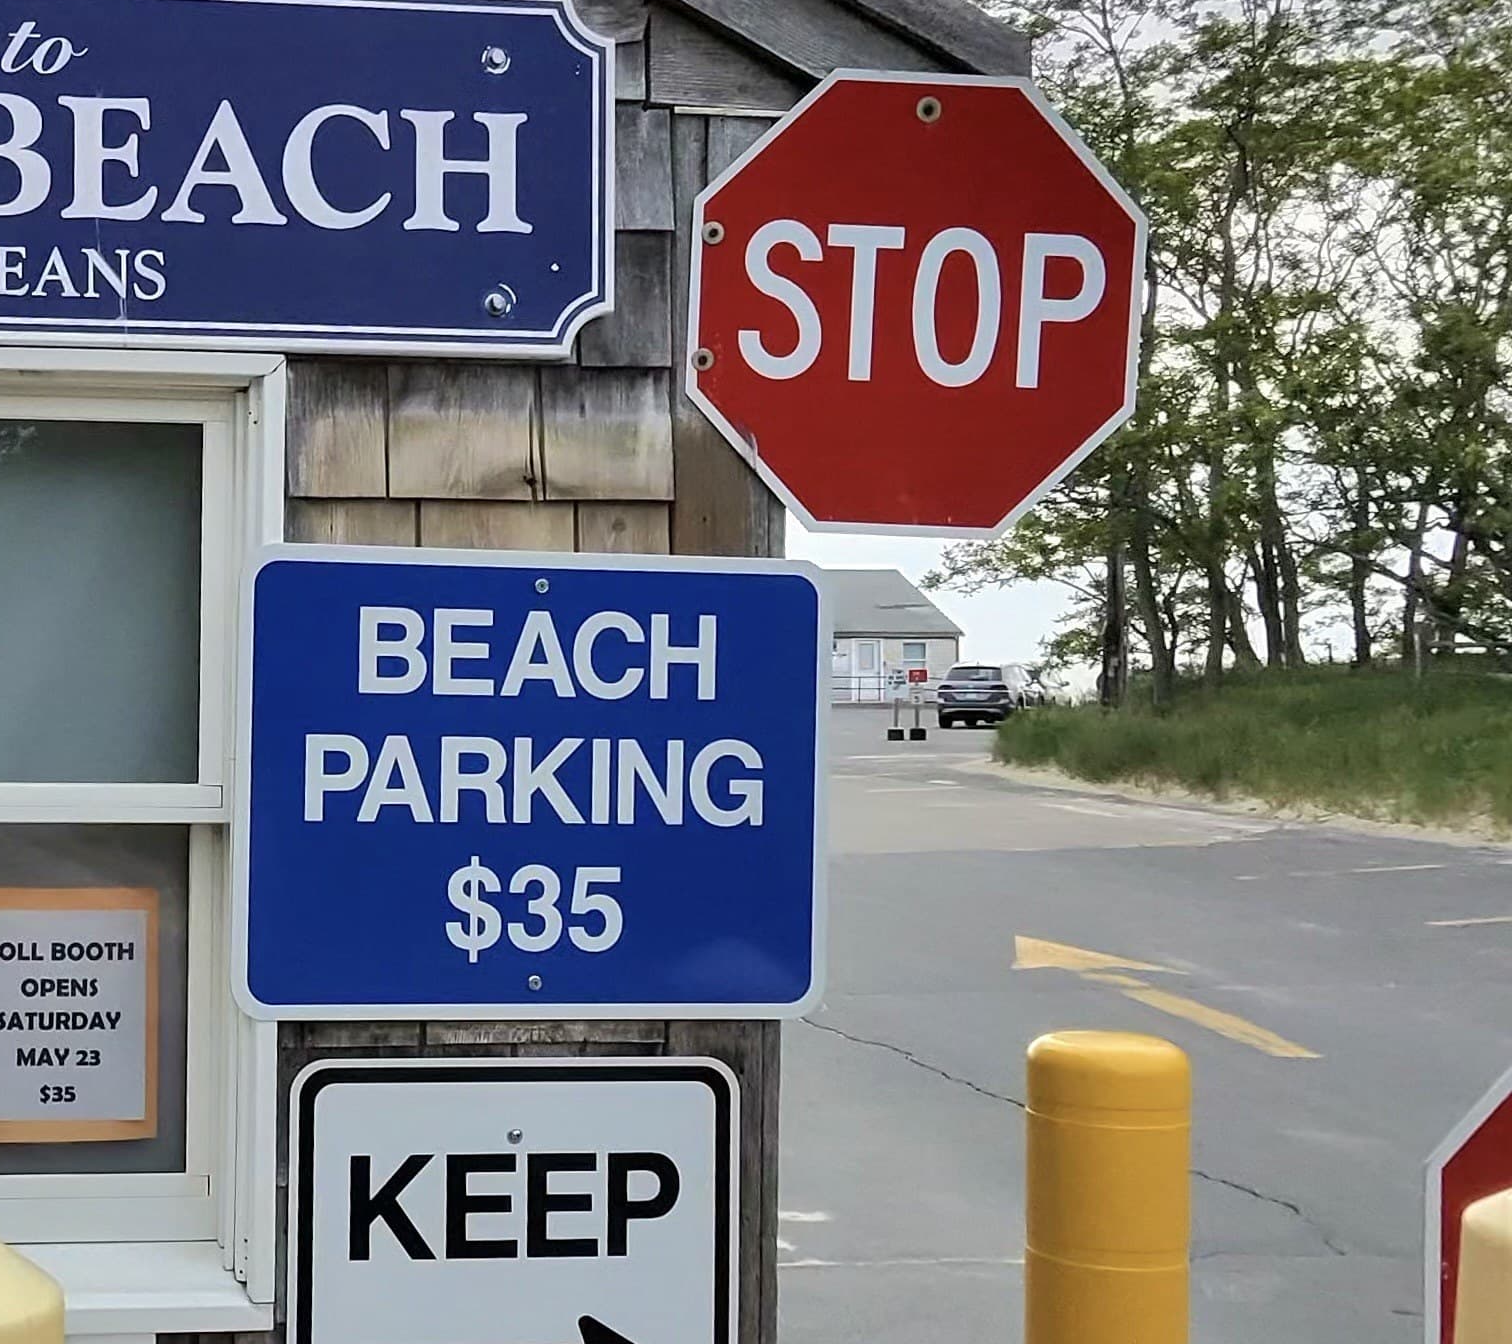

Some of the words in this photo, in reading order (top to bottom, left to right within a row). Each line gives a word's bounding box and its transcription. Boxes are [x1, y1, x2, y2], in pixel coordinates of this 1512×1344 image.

[0, 21, 88, 75] to
[738, 219, 1106, 389] STOP
[357, 606, 717, 701] BEACH
[303, 733, 764, 827] PARKING
[444, 855, 624, 963] $35
[20, 978, 99, 997] OPENS
[51, 943, 135, 961] BOOTH
[16, 1048, 70, 1067] MAY
[76, 1050, 101, 1067] 23
[39, 1084, 76, 1104] $35
[348, 1152, 681, 1261] KEEP
